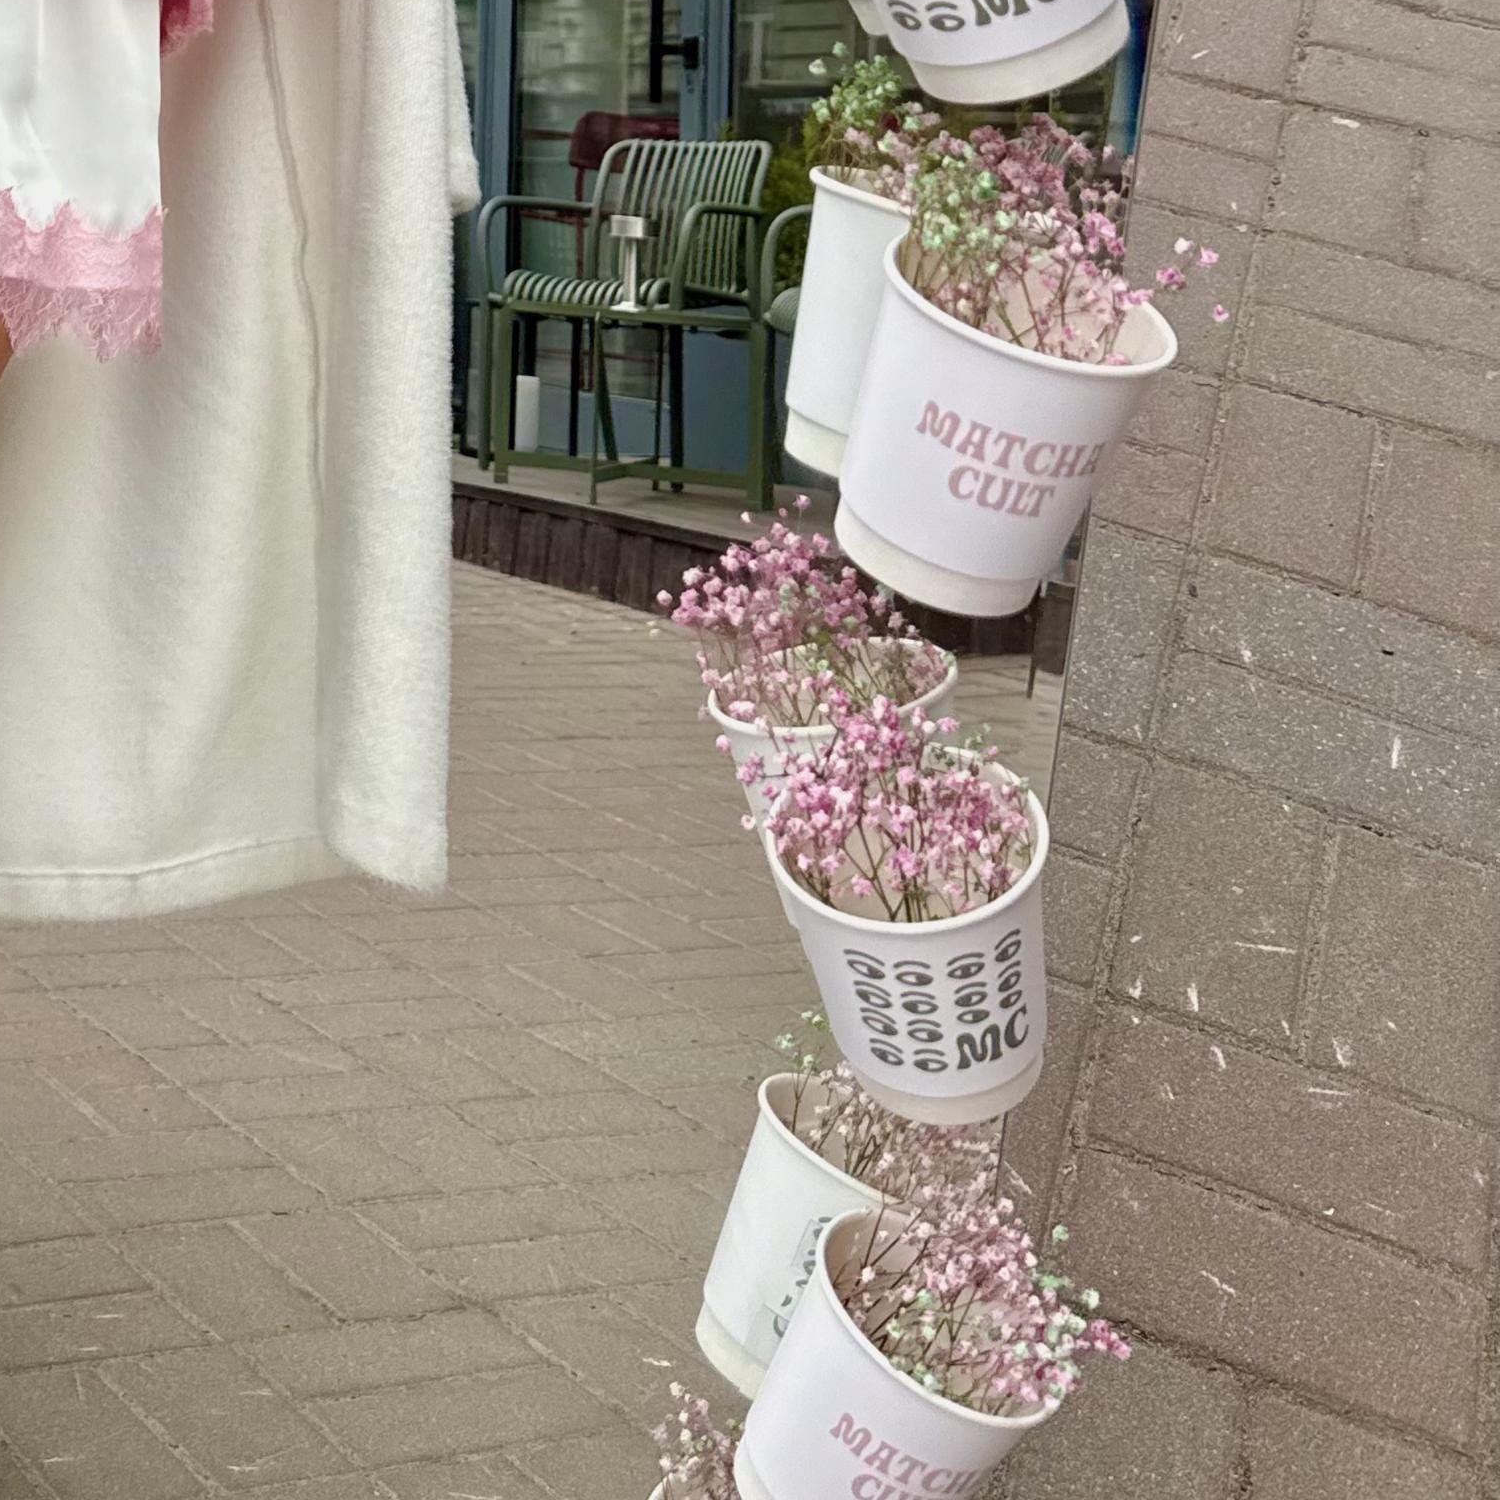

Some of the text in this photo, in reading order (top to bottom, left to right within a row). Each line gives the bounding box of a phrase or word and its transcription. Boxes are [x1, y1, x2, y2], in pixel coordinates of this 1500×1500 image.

[948, 465, 1056, 519] CULT
[956, 1005, 1030, 1071] MC
[829, 1412, 981, 1496] MATCH
